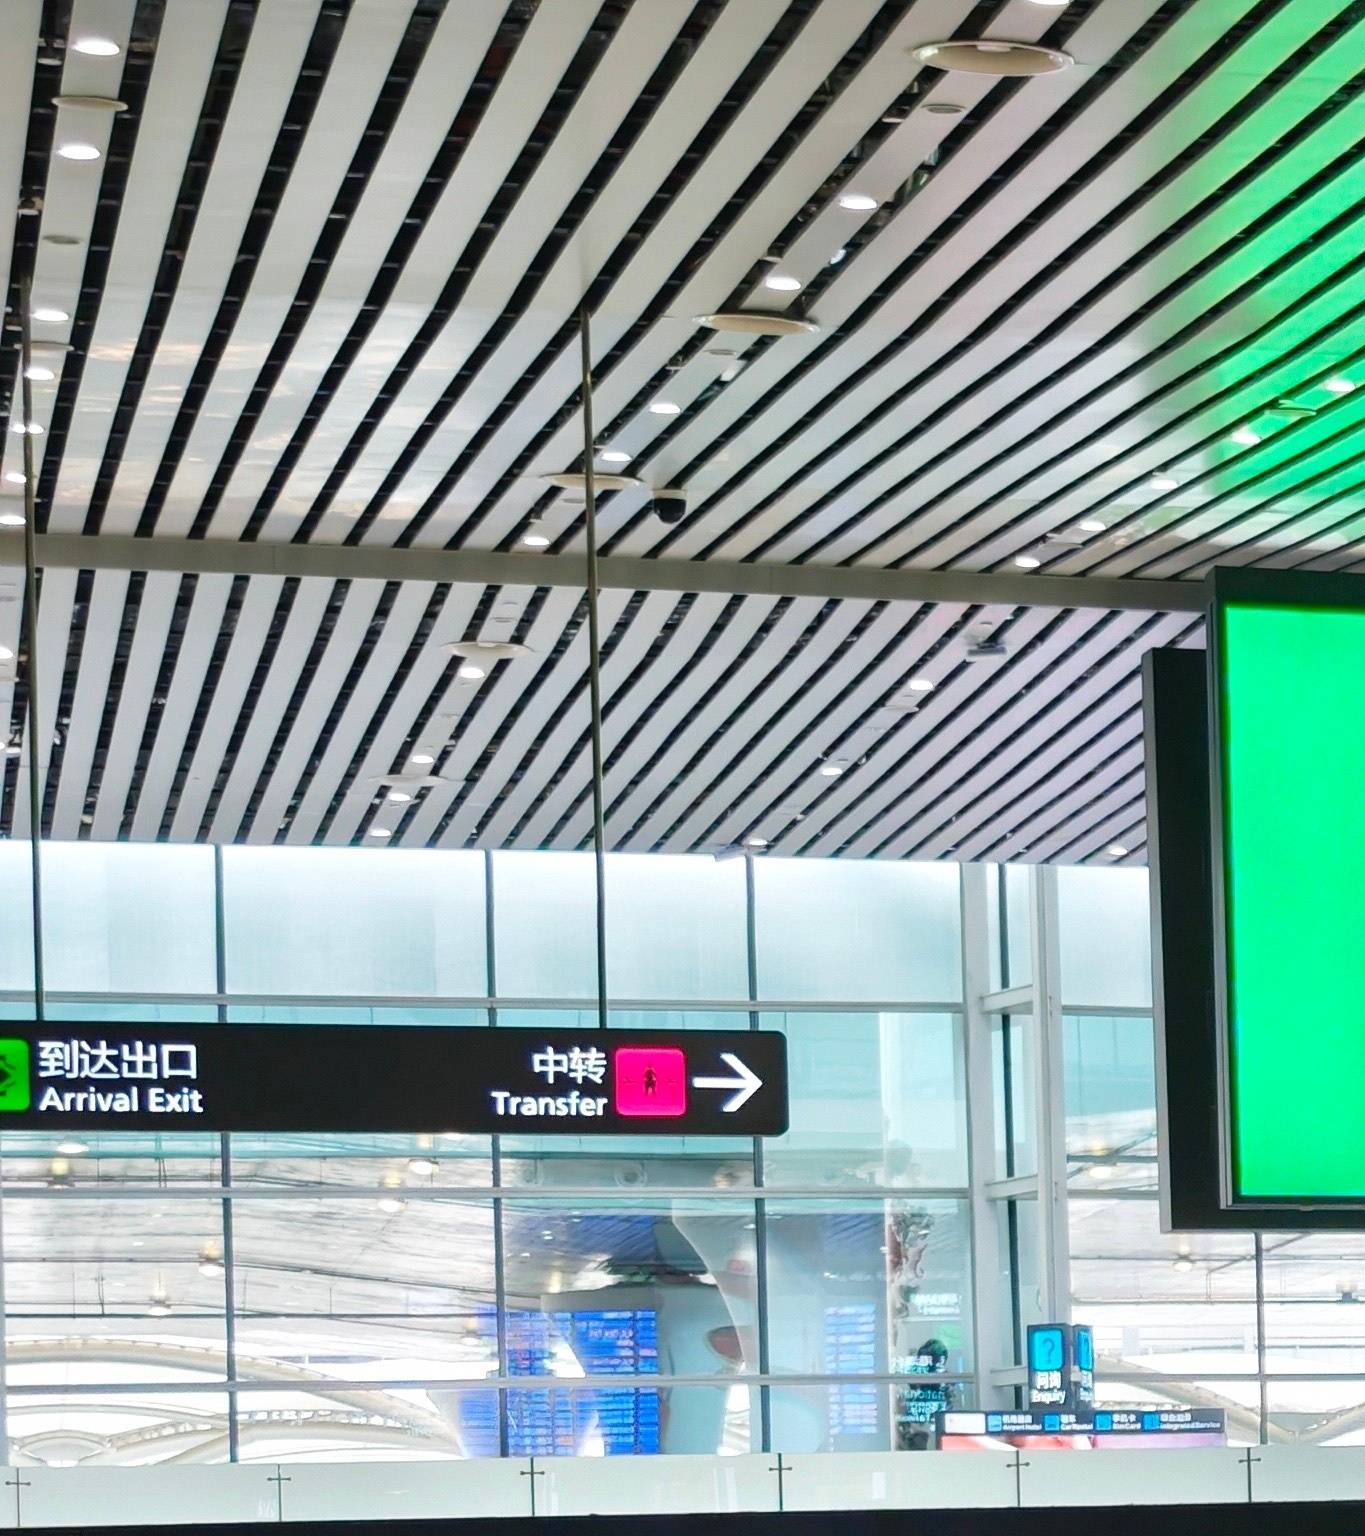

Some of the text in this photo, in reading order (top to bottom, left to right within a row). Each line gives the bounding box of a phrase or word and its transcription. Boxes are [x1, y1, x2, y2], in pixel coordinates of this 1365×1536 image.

[37, 1040, 199, 1080] 到达出口
[531, 1046, 608, 1085] 中转
[39, 1086, 204, 1113] Arrival Exit
[490, 1090, 608, 1117] Transfer
